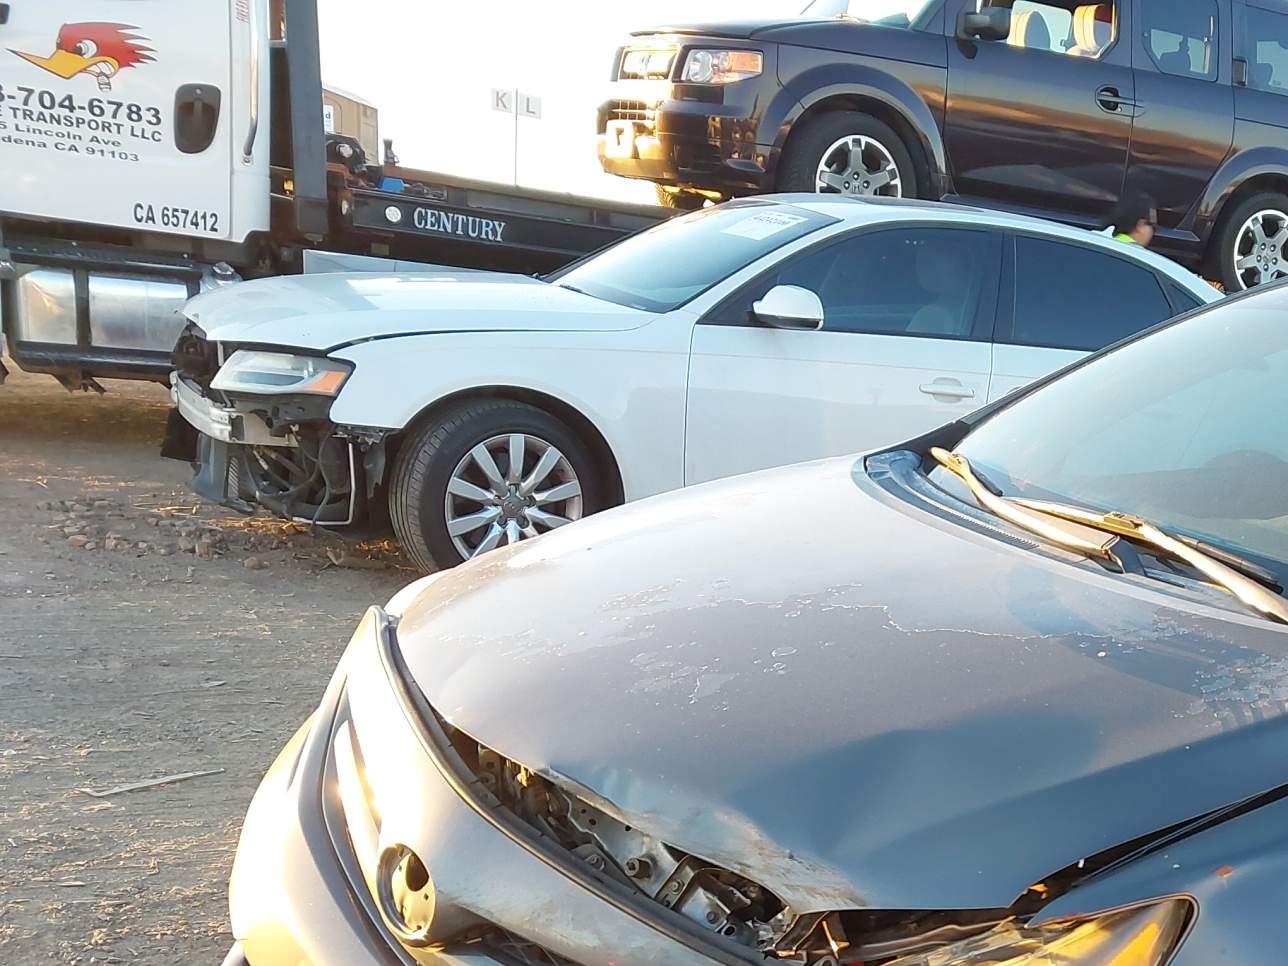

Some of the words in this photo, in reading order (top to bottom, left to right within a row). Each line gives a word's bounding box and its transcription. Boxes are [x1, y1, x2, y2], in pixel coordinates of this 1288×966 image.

[495, 90, 507, 109] K
[526, 96, 536, 115] L
[8, 106, 124, 135] TRANSPORT
[130, 125, 162, 142] LLC
[15, 123, 82, 141] Lincoln
[89, 135, 121, 147] Ave
[54, 142, 80, 153] CA
[85, 147, 140, 162] 91103
[133, 202, 156, 224] CA
[161, 206, 218, 232] 657412
[413, 207, 506, 242] CENTURY
